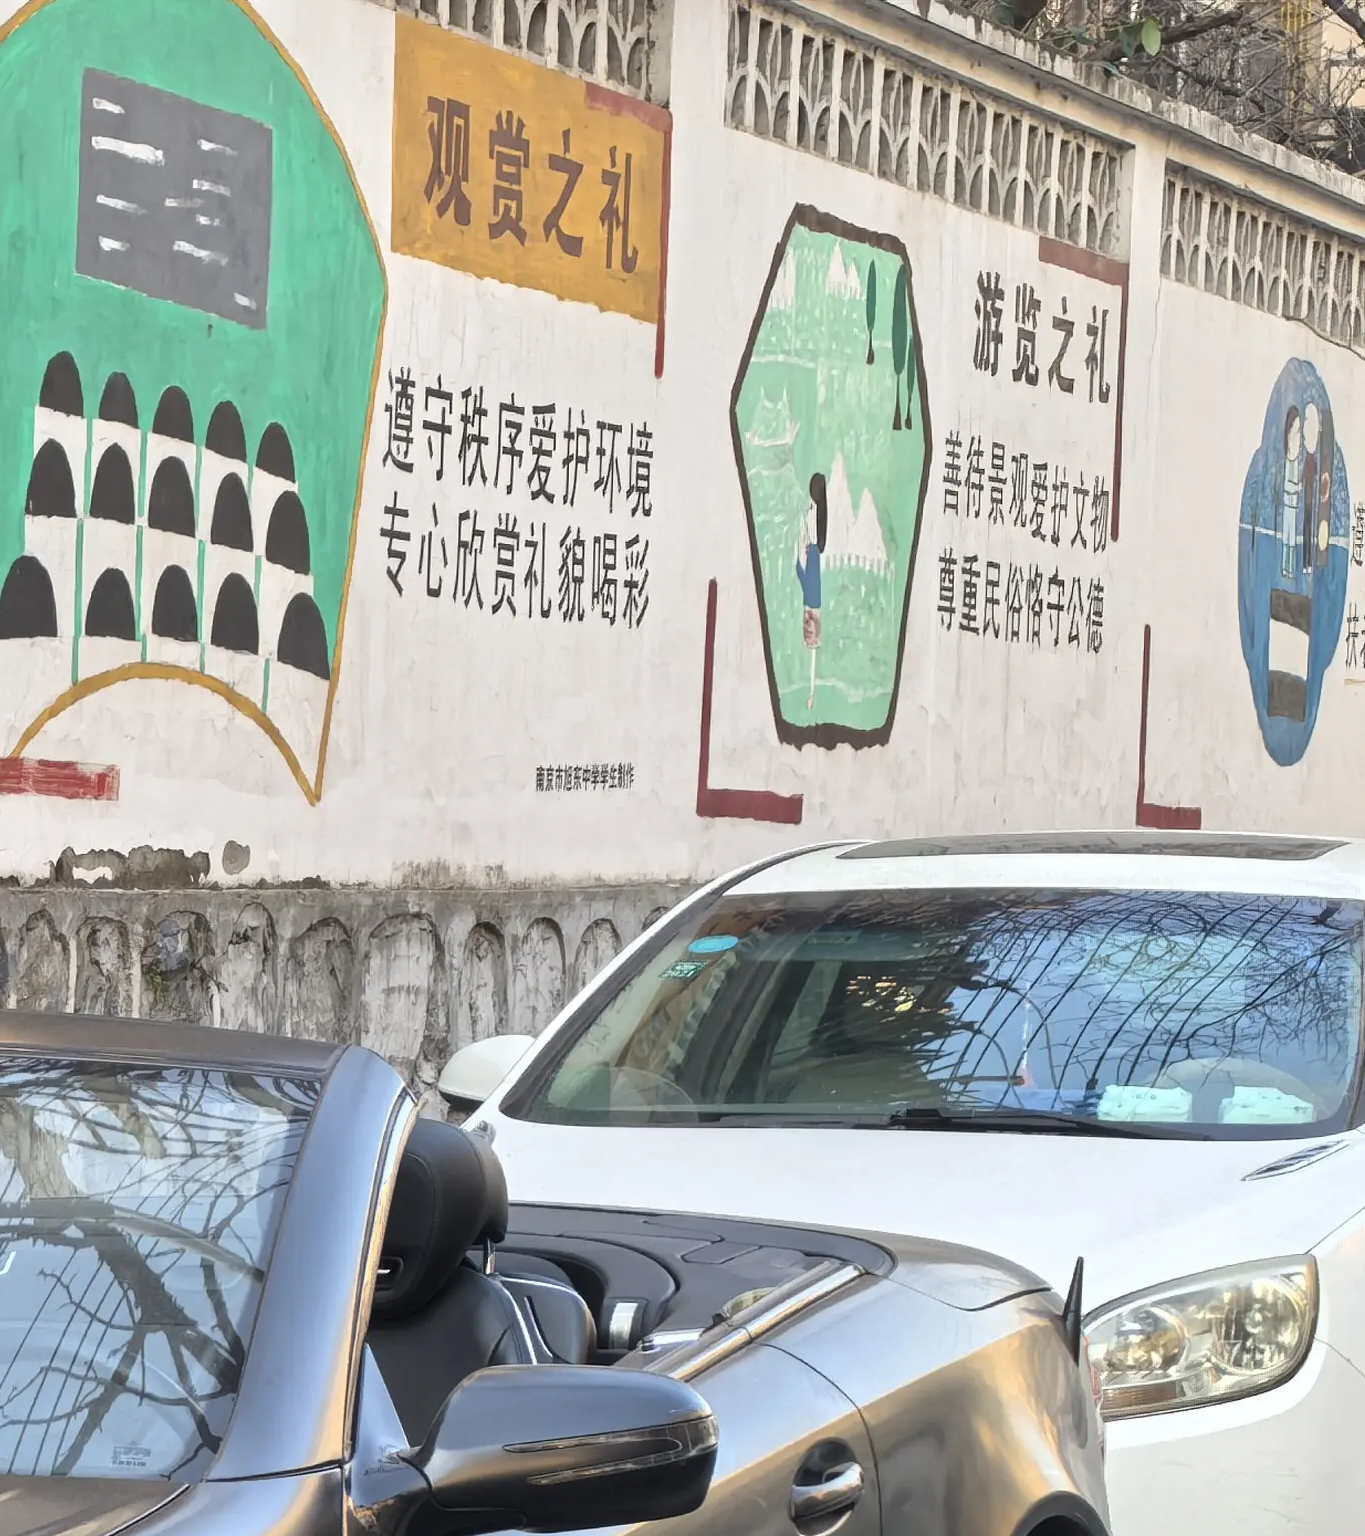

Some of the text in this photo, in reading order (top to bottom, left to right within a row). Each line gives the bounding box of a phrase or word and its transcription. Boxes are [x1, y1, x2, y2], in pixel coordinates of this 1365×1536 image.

[423, 95, 639, 274] 观赏之礼
[973, 270, 1110, 403] 游览之礼
[382, 366, 654, 517] 遵守秩序爱护环境
[943, 429, 1109, 553] 善待景观爱护文物
[380, 490, 649, 629] 专心欣赏礼貌喝彩
[937, 546, 1105, 654] 尊重民俗恪守公德
